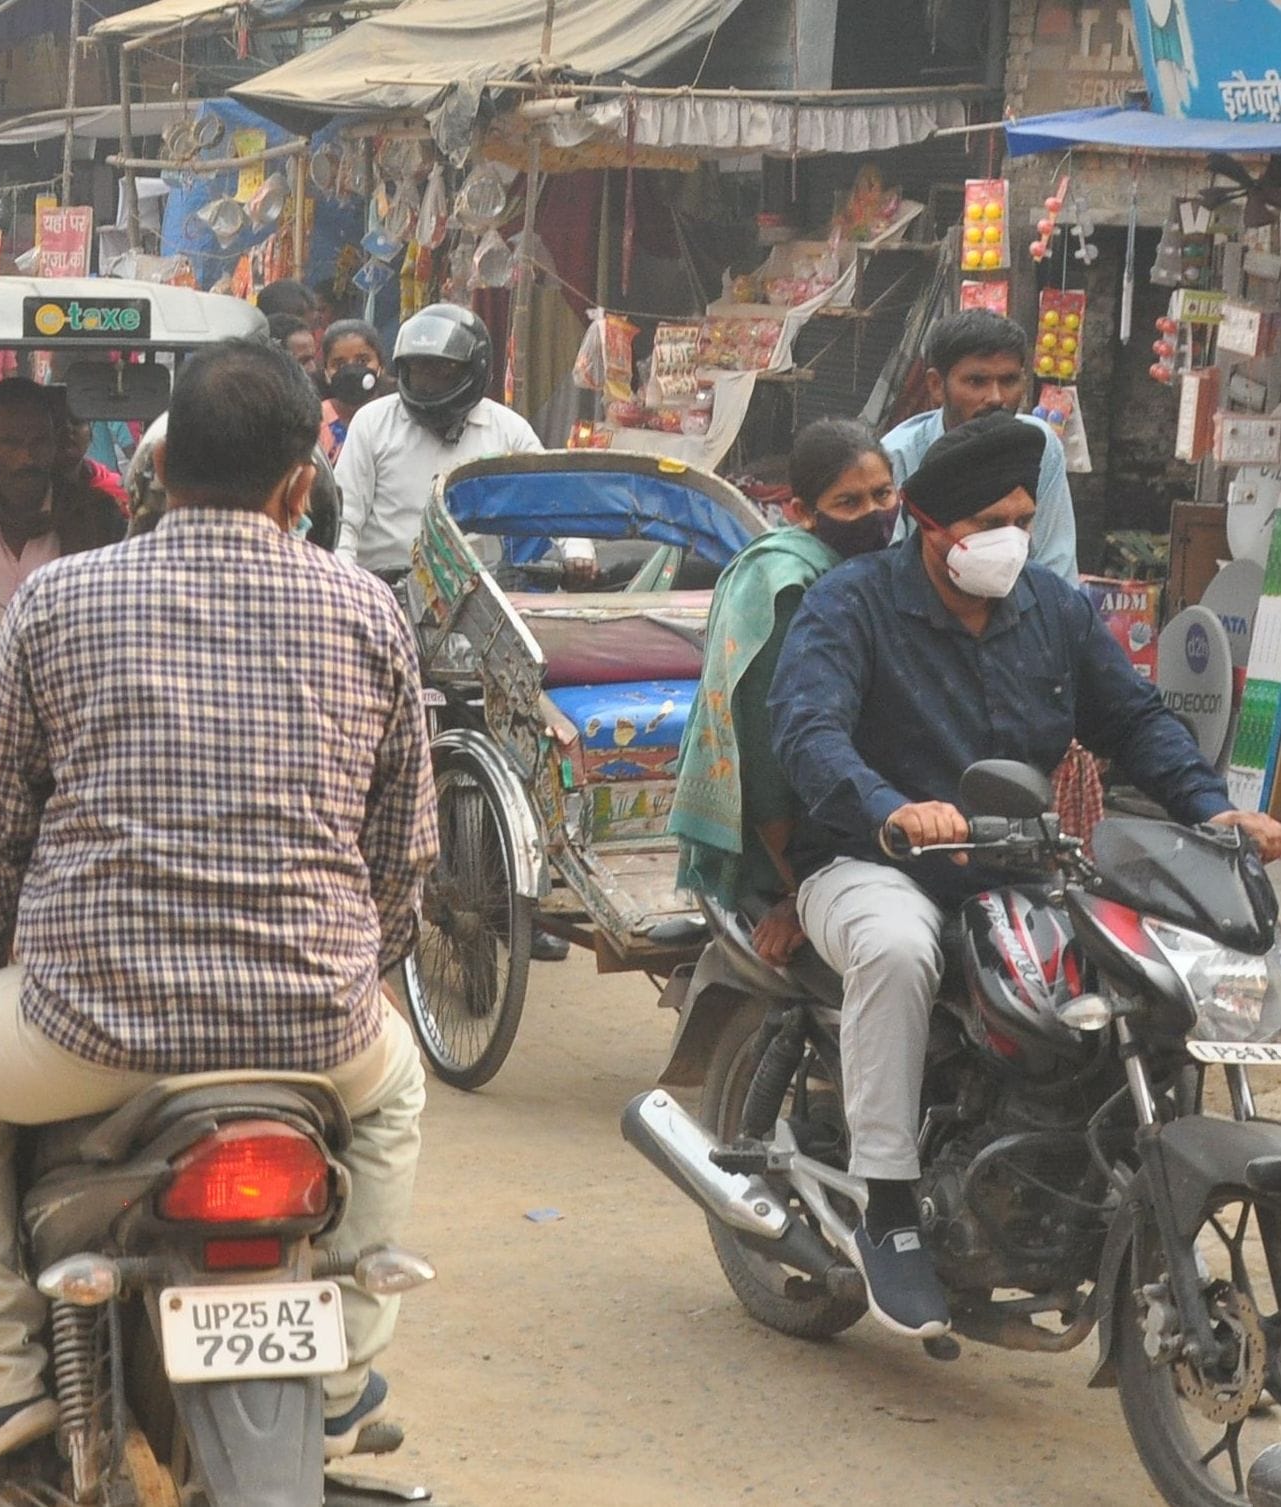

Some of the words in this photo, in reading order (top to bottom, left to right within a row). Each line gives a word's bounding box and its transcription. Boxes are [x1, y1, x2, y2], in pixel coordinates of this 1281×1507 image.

[69, 213, 88, 232] पर
[1101, 592, 1148, 611] ADM
[192, 1303, 269, 1331] UP25
[276, 1300, 314, 1327] AZ
[195, 1331, 318, 1366] 7963
